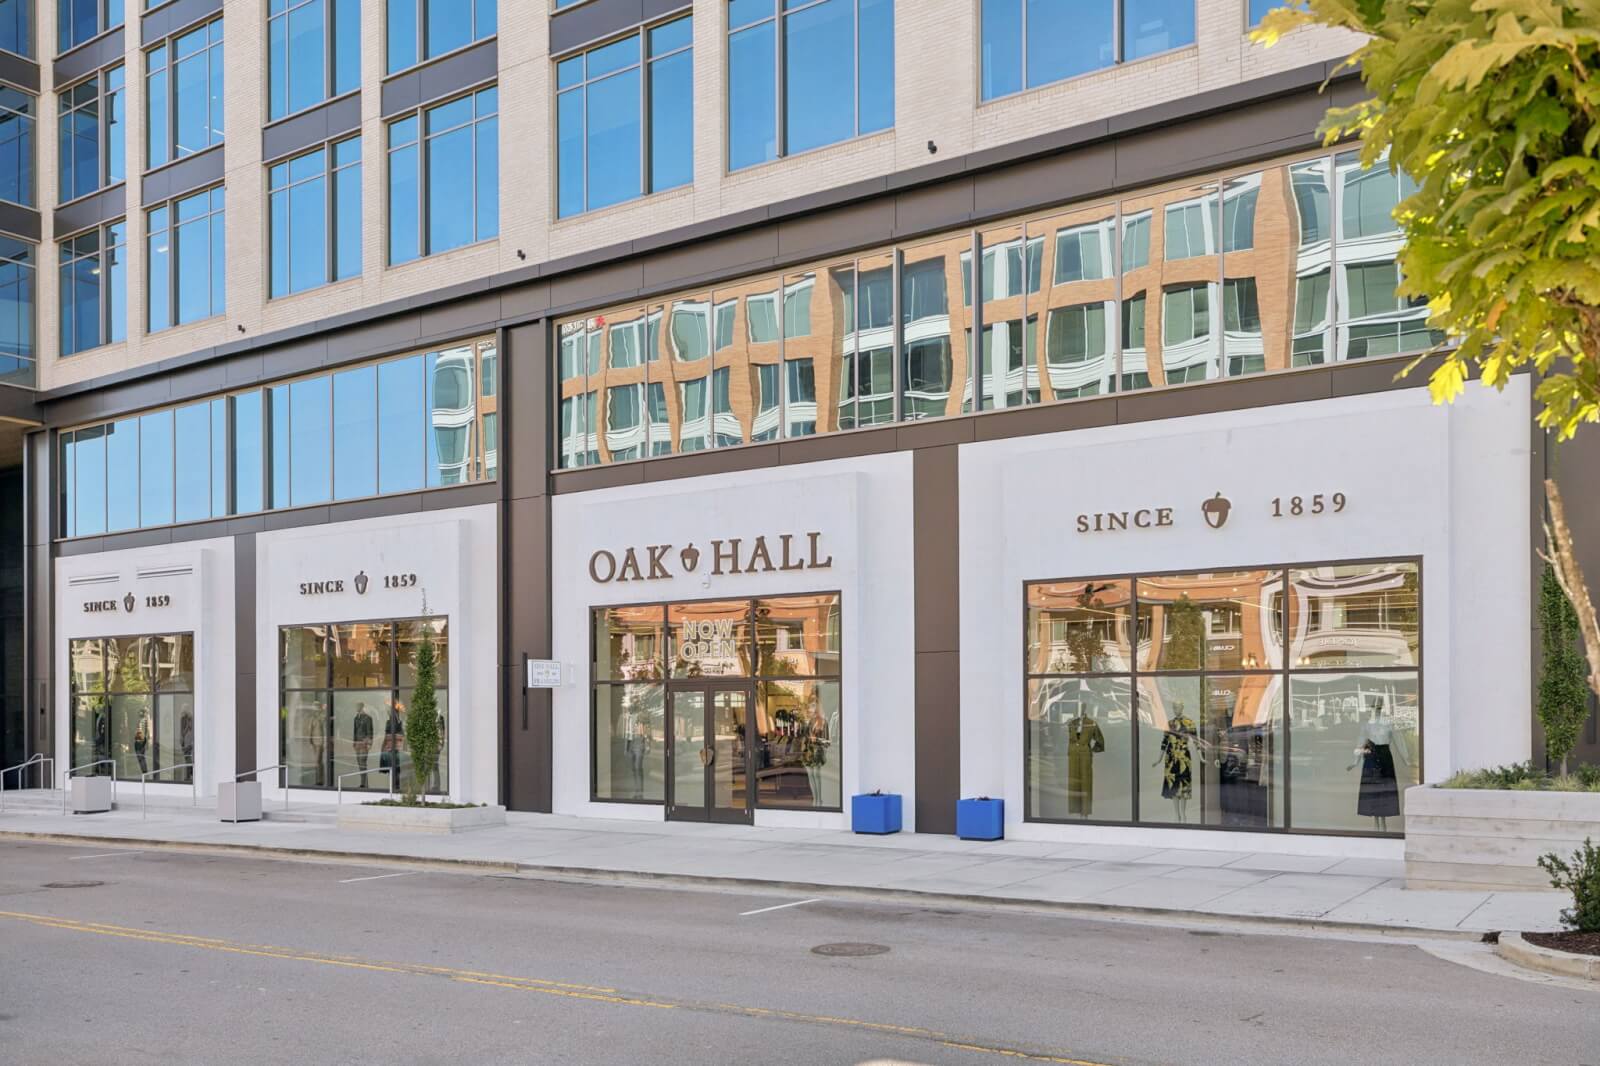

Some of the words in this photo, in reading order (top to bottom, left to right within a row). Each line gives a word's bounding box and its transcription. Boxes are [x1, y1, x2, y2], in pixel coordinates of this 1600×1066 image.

[1077, 507, 1174, 533] SINCE
[1271, 492, 1347, 518] 1859
[588, 544, 674, 584] OAK
[710, 531, 833, 576] HALL
[299, 580, 344, 596] SINCE
[383, 573, 417, 589] 1859
[83, 599, 117, 613] SINCE
[145, 594, 171, 608] 1859
[682, 618, 734, 640] NOW
[680, 640, 736, 661] OPEN
